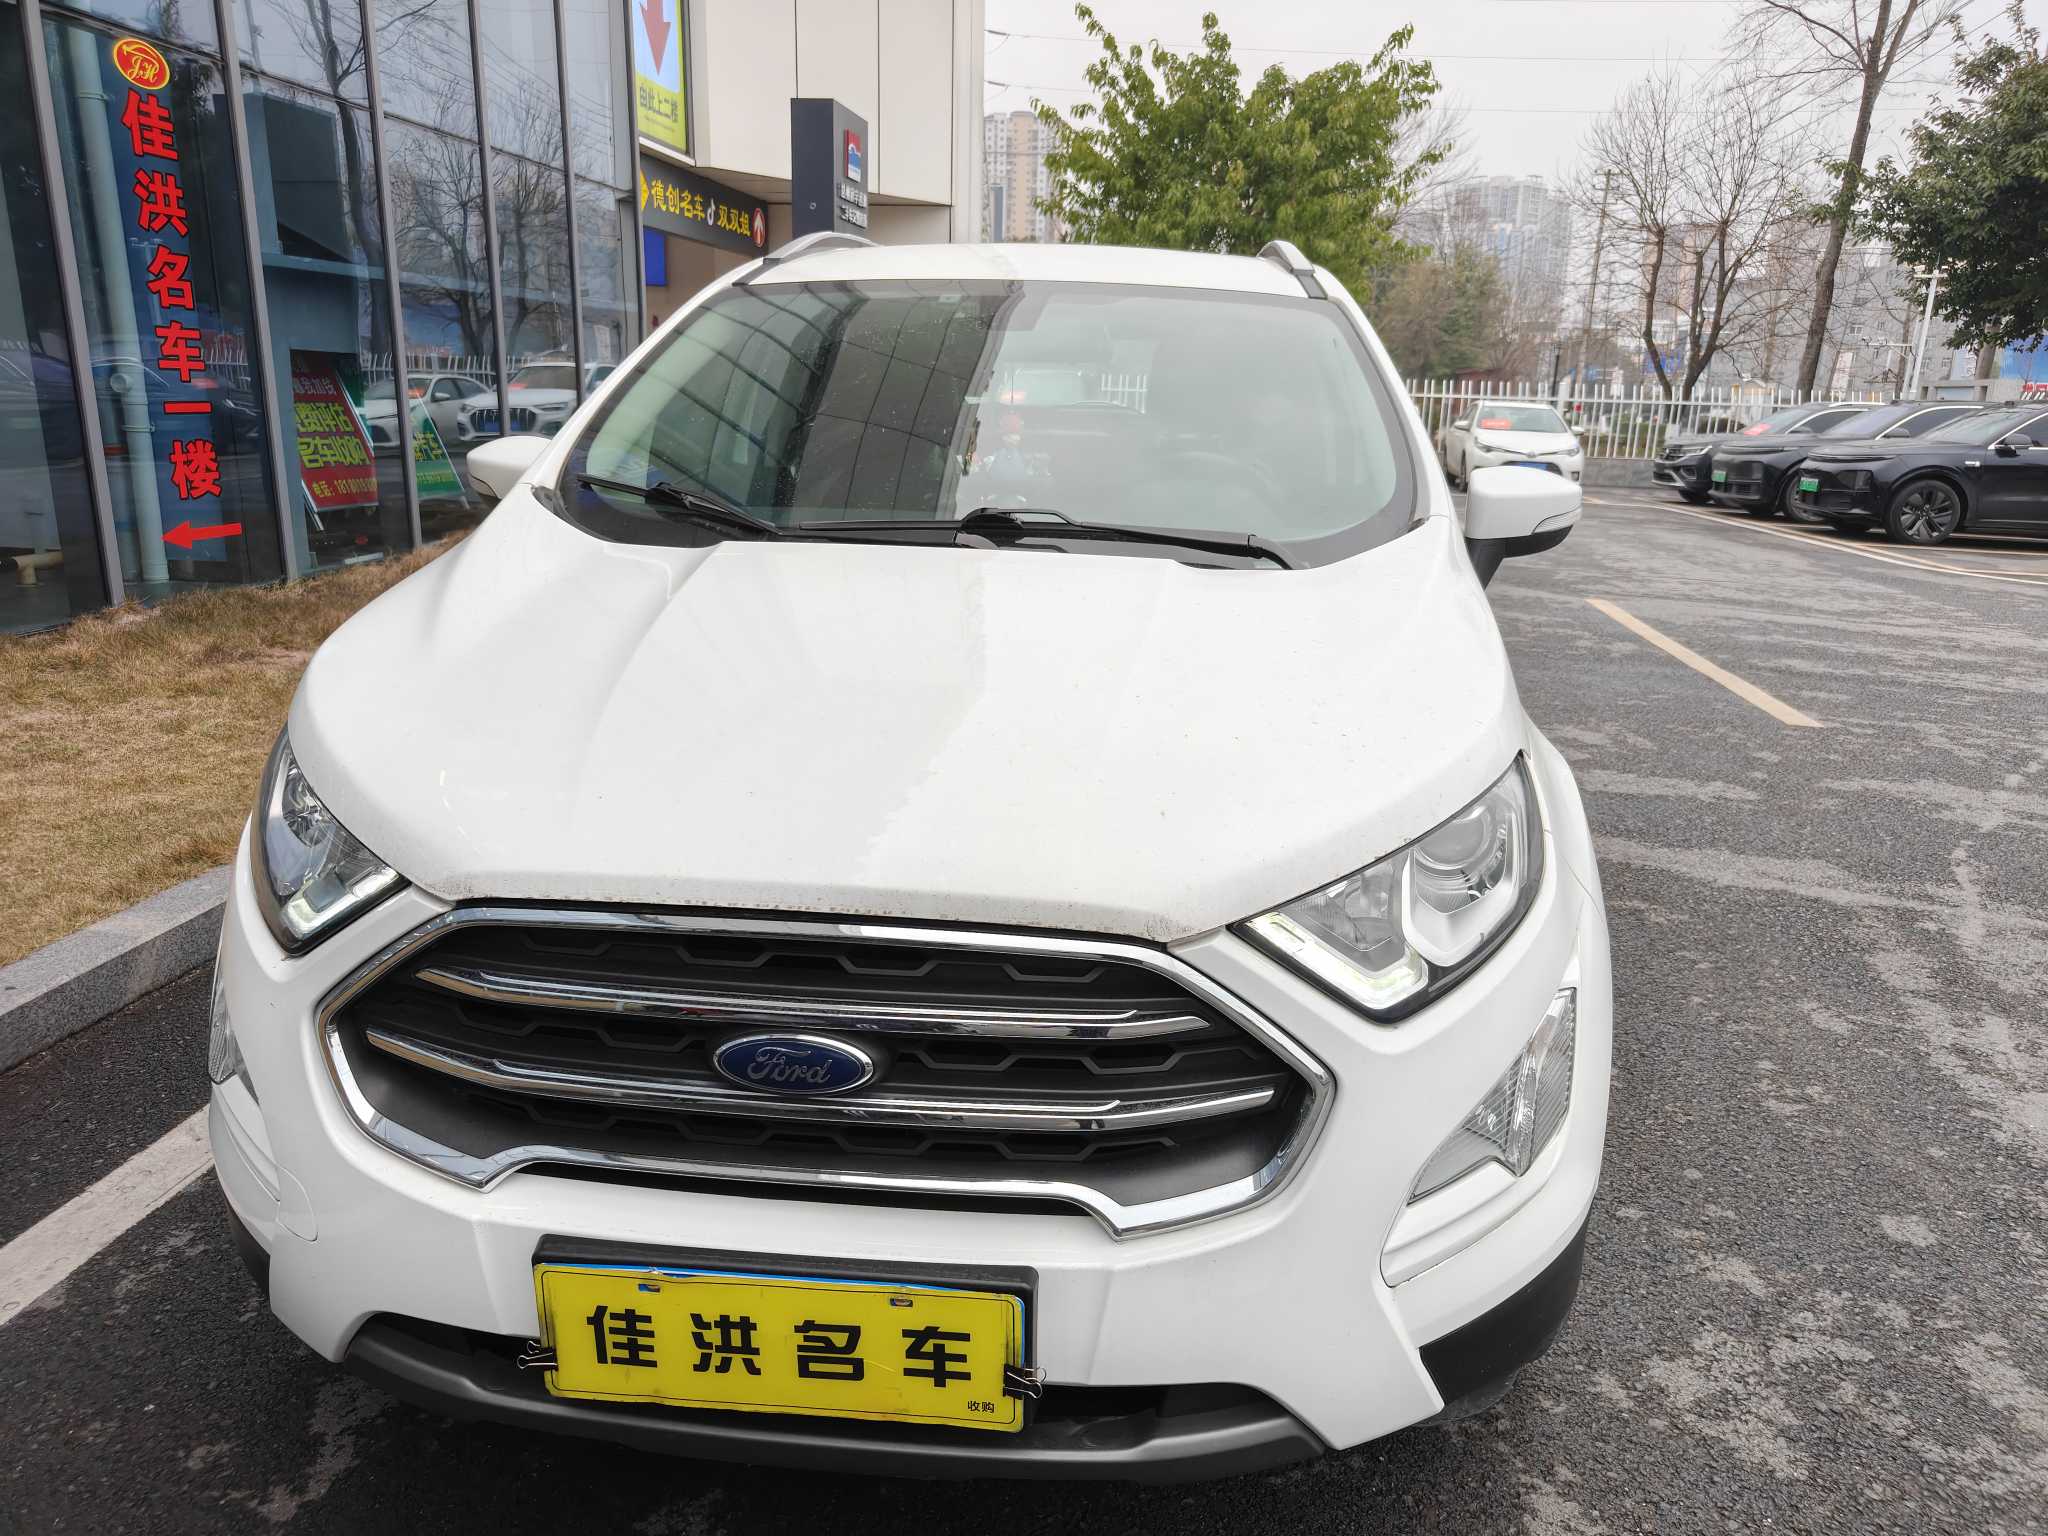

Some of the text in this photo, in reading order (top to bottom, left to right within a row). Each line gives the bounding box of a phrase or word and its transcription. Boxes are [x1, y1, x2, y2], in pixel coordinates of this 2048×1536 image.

[651, 179, 705, 222] 德创名车
[120, 89, 221, 501] 佳洪名车一楼
[747, 1046, 833, 1085] Ford
[586, 1304, 973, 1388] 佳洪名车
[967, 1400, 995, 1413] 收购
